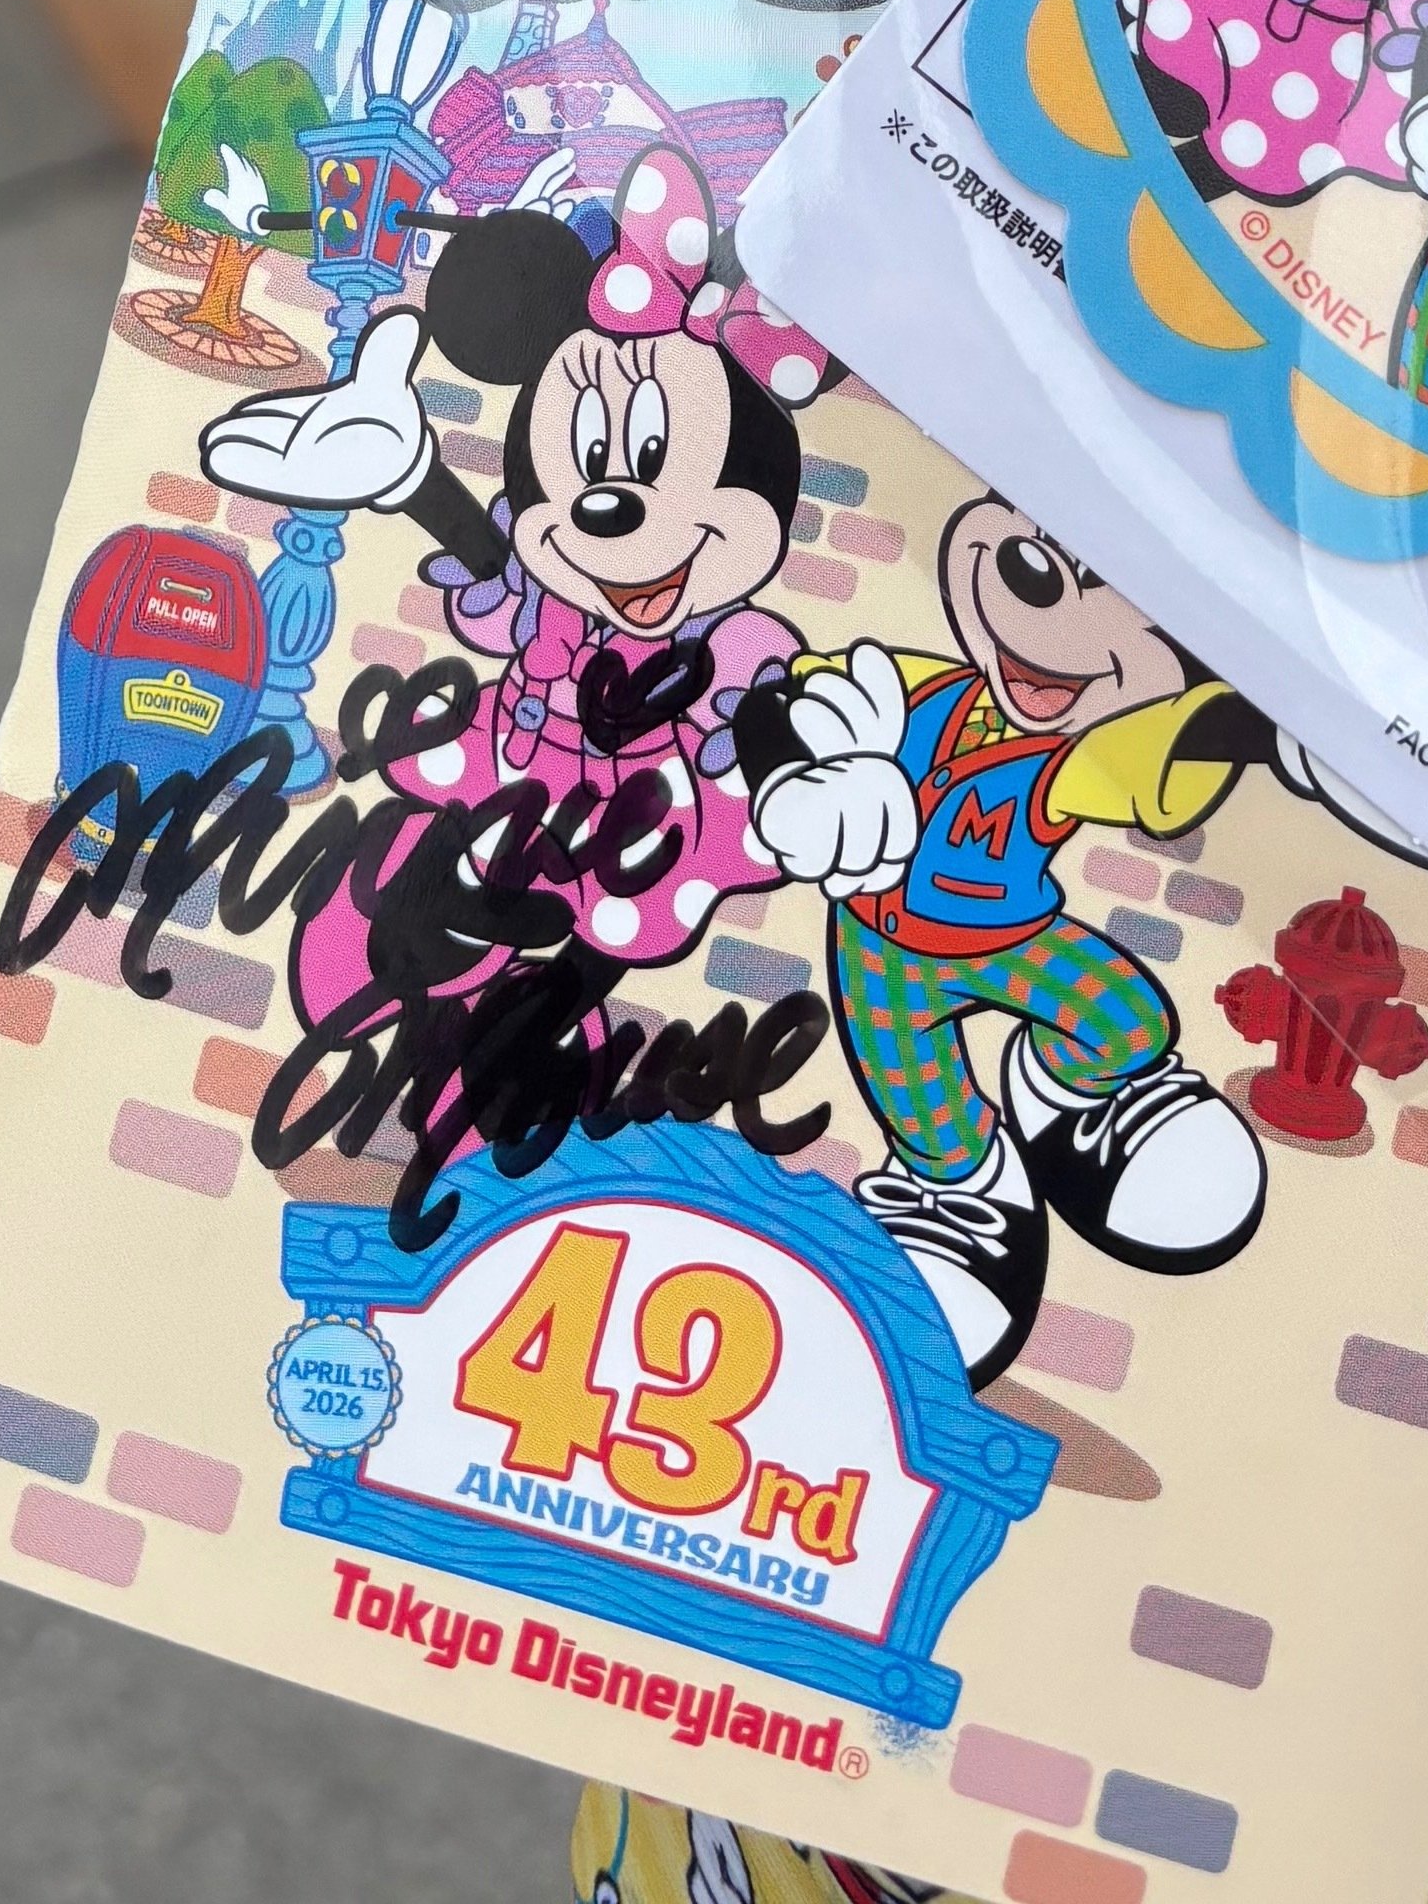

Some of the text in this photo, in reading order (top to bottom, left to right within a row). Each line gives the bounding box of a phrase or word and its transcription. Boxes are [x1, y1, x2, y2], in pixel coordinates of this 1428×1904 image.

[147, 597, 219, 630] PULL OPEN
[135, 690, 212, 722] TOONTOWN
[285, 1356, 356, 1388] APRIL
[301, 1388, 364, 1420] 2026
[453, 1221, 870, 1565] 43rd
[455, 1461, 831, 1609] ANNIVERSARY
[330, 1558, 501, 1671] Tokyo
